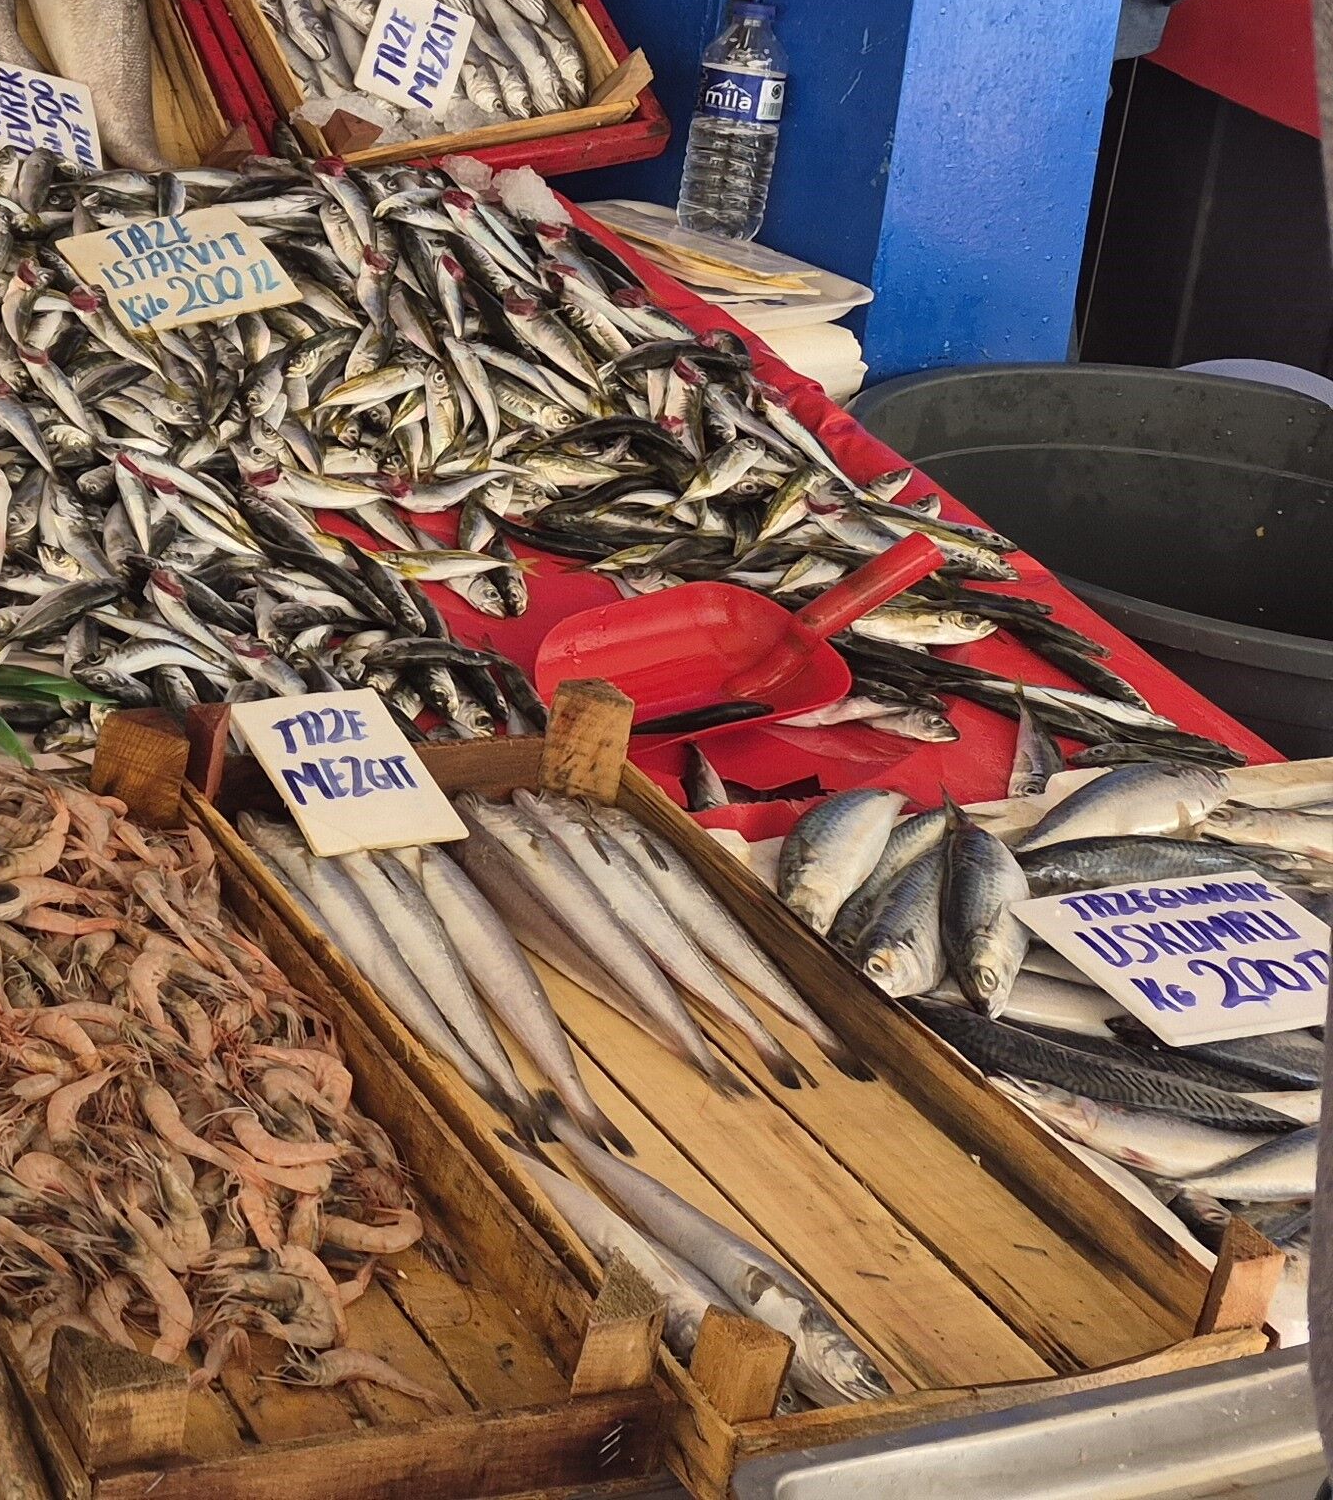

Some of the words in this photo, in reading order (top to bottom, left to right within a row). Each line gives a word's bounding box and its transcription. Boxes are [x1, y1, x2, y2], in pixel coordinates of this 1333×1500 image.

[372, 7, 417, 86] TAZE
[28, 78, 73, 134] 500
[705, 89, 753, 111] mila
[105, 215, 193, 258] TAZE
[167, 265, 244, 317] 200
[246, 259, 281, 293] TL
[271, 707, 369, 754] TAZE
[280, 754, 419, 806] MEZGIT
[1072, 909, 1302, 968] USKUMRU
[1186, 954, 1313, 1010] 200
